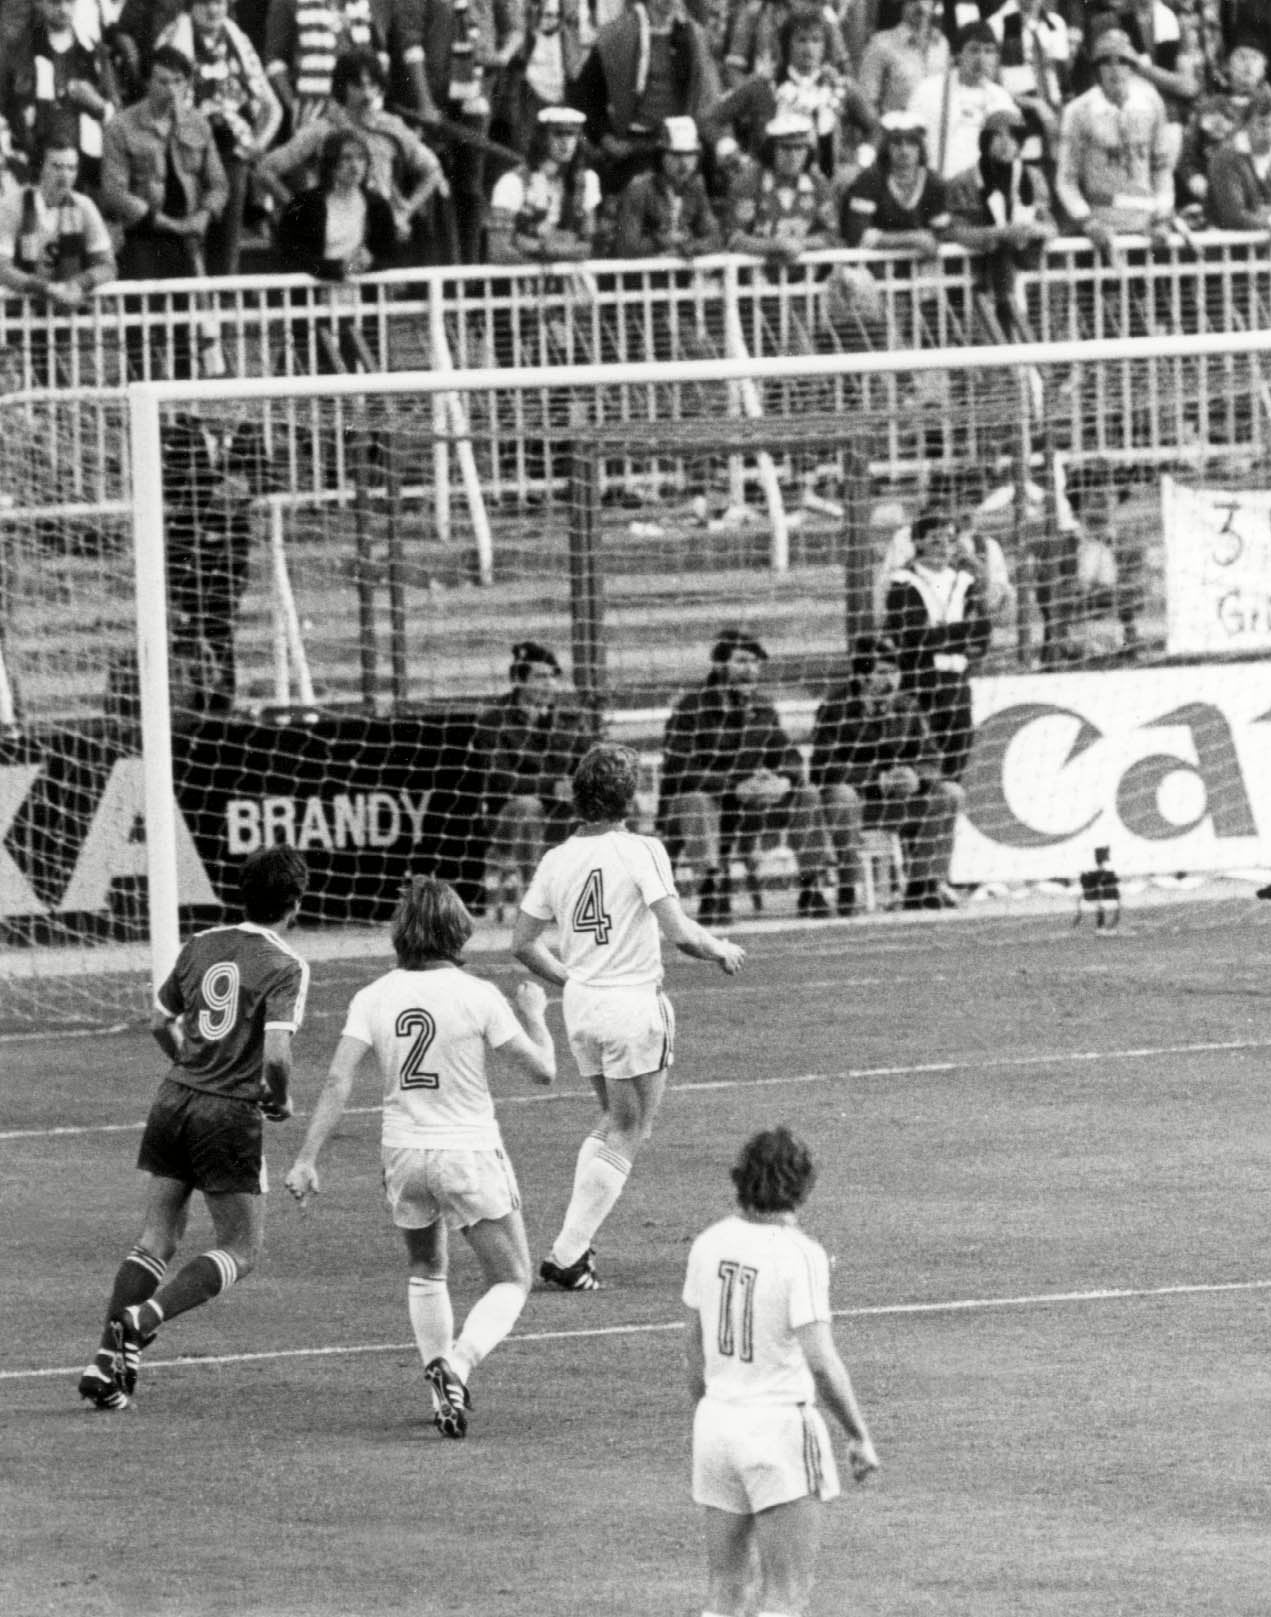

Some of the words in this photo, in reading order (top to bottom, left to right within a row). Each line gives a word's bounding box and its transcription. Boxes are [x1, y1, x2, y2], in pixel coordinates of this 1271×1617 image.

[1212, 501, 1244, 567] 3
[227, 789, 434, 856] BRANDY
[572, 868, 612, 946] 4
[199, 961, 241, 1042] 9
[395, 1007, 441, 1091] 2
[716, 1259, 759, 1364] 11
